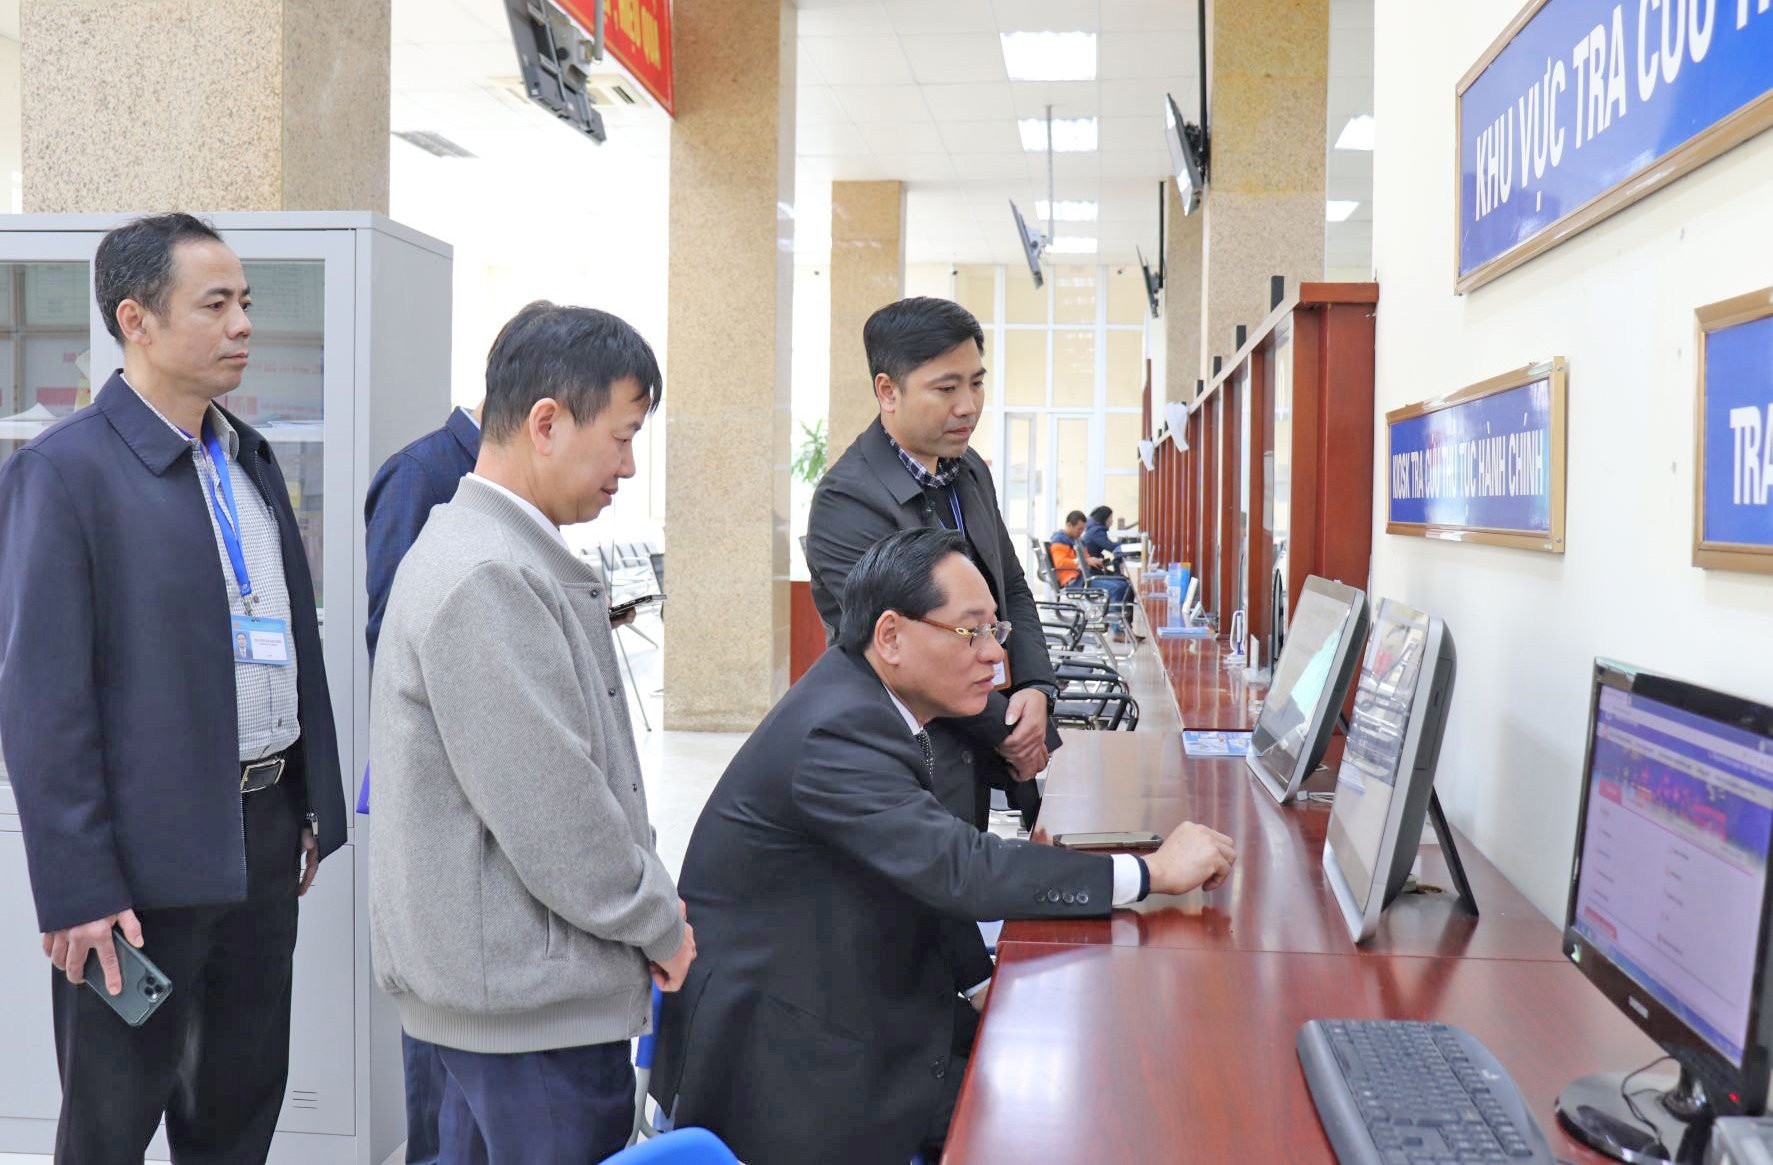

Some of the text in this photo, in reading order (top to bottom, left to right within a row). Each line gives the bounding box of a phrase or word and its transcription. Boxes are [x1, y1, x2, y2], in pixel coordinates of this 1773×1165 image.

[1475, 106, 1513, 221] KHU
[1518, 57, 1566, 212] VỰC
[1573, 5, 1627, 150] TRA
[1391, 452, 1410, 499] KIOSK
[1411, 450, 1424, 499] TRA
[1478, 421, 1506, 497] HÀNH
[1508, 411, 1543, 497] CHÍNH
